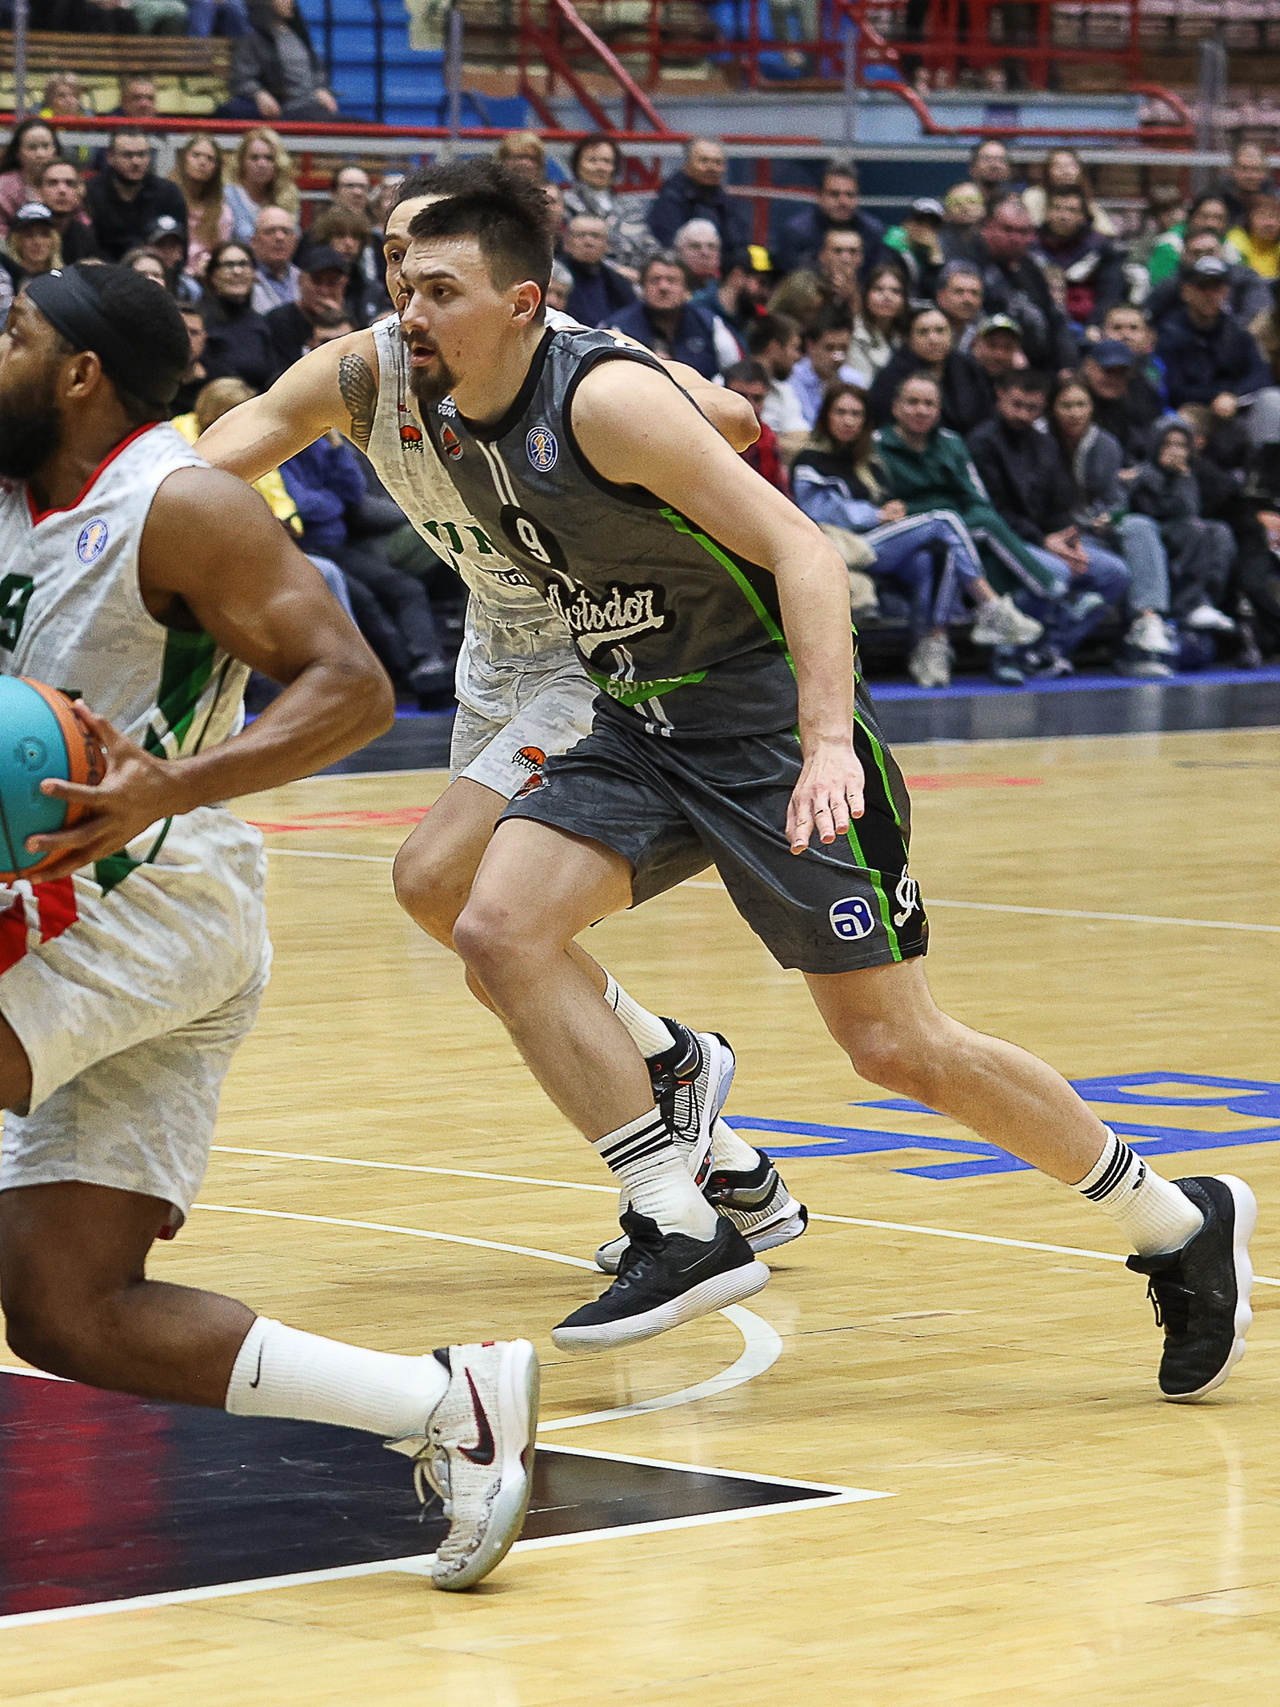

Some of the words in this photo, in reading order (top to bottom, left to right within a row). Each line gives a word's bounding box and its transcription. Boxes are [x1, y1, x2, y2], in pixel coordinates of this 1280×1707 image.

[437, 403, 457, 418] PEAK
[516, 518, 551, 564] 9
[513, 751, 543, 773] UNIC
